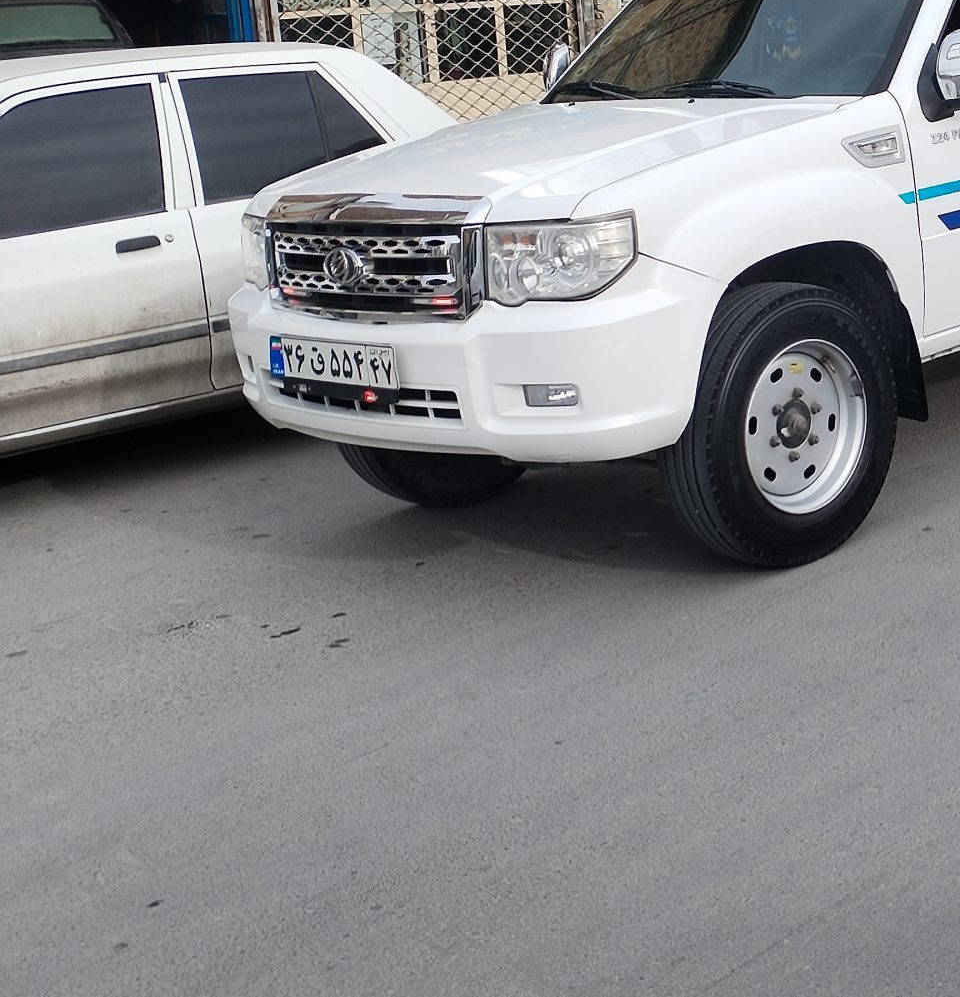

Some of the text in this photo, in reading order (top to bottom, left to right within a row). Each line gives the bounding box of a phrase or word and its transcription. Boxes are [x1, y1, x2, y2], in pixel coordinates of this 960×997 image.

[930, 132, 950, 145] Z24
[283, 342, 364, 380] ۳۶ ق ۵۵۴
[369, 357, 392, 385] ۴۷
